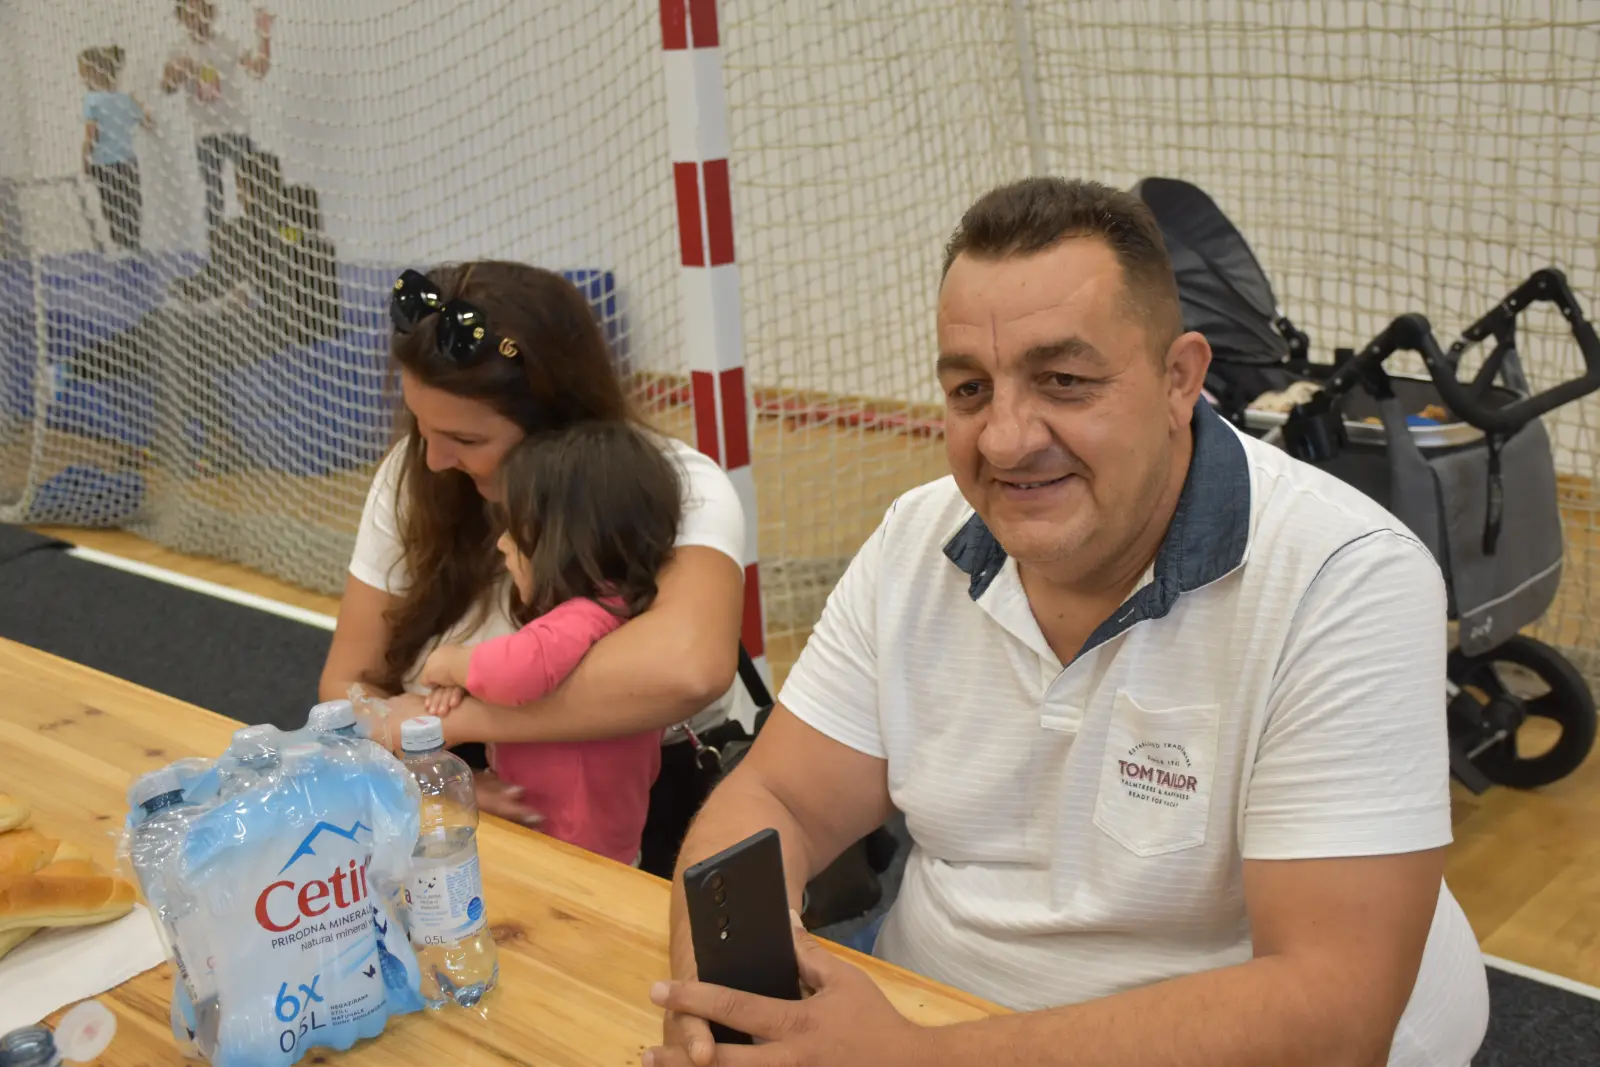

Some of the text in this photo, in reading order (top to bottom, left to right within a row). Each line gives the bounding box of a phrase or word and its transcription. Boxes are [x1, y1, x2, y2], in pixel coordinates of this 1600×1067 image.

[1118, 759, 1198, 793] TOM TAILOR
[1128, 790, 1150, 801] READY
[1151, 796, 1162, 805] FOR
[254, 854, 372, 932] Ceti
[271, 903, 373, 950] PRIRODNA MINERAL
[301, 919, 369, 951] Natural mineral
[331, 1008, 349, 1016] STILL
